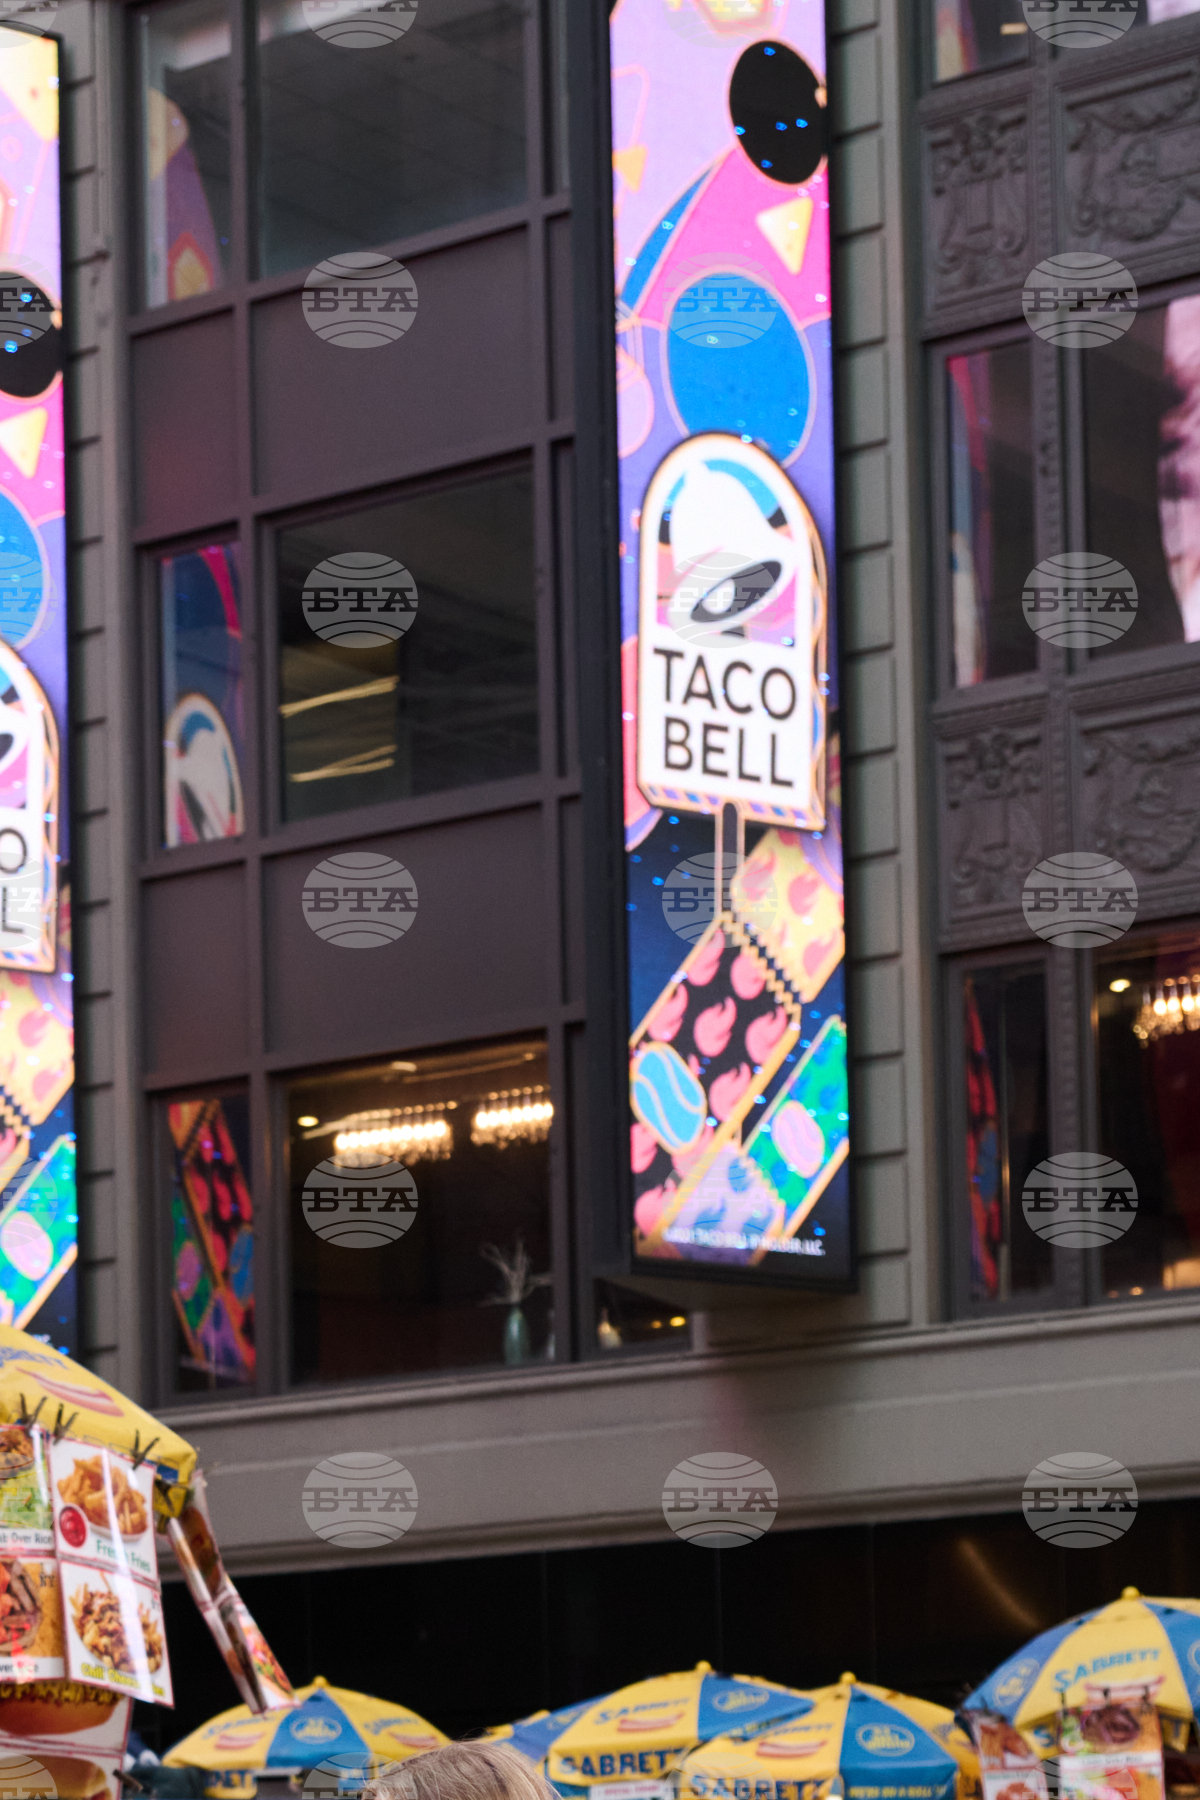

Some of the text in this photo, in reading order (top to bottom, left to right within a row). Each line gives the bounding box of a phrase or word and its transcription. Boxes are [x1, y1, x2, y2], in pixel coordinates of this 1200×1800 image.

[653, 647, 796, 721] TACO
[665, 716, 793, 788] BELL
[11, 1532, 31, 1544] Over
[35, 1532, 52, 1544] Rice
[130, 1551, 151, 1573] Fries
[81, 1661, 104, 1680] Chili
[559, 1747, 685, 1777] SABRET
